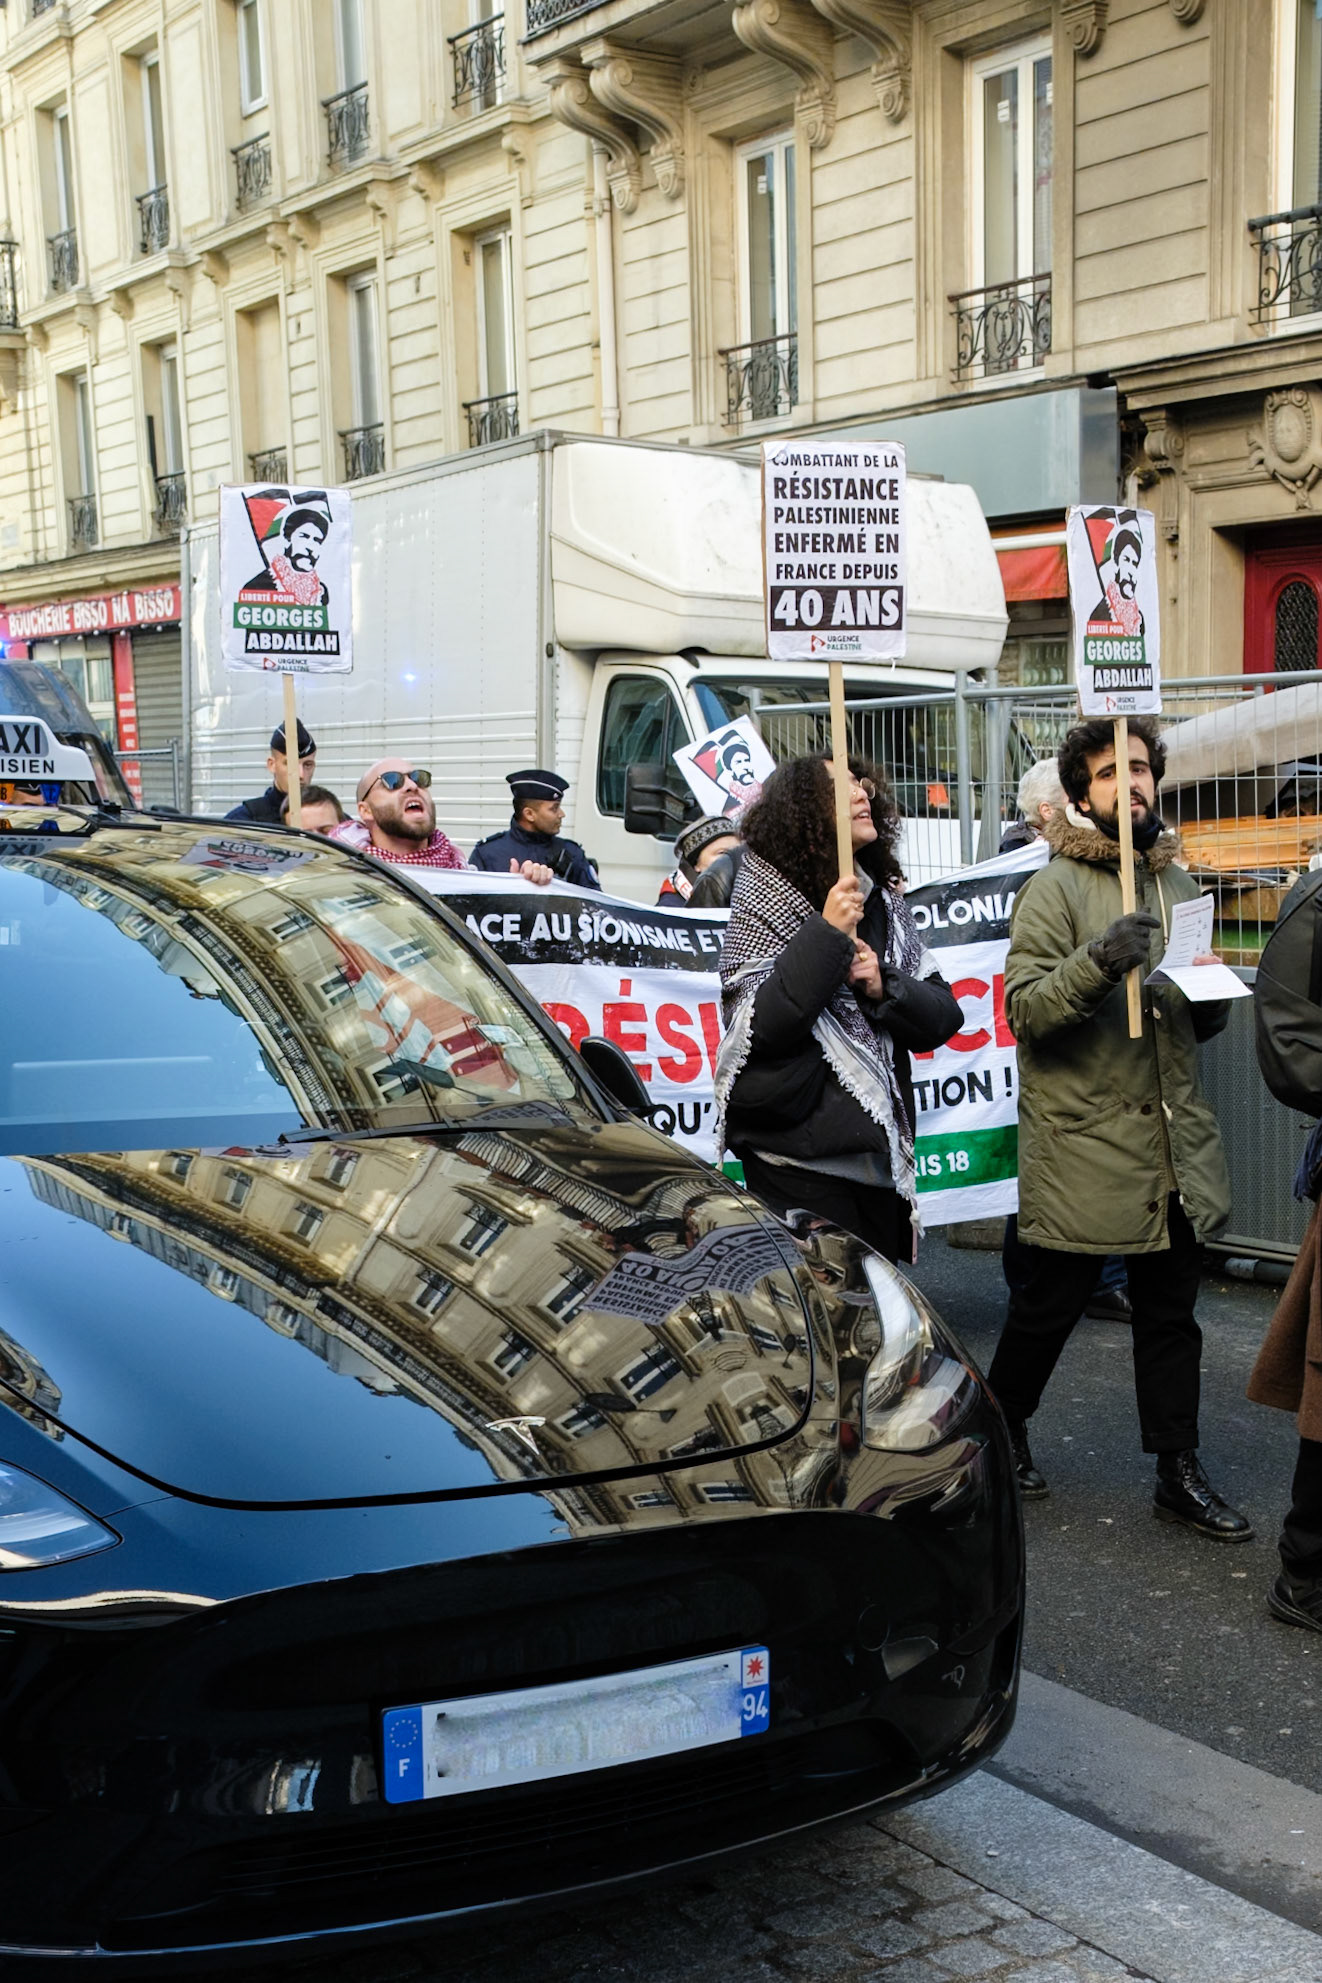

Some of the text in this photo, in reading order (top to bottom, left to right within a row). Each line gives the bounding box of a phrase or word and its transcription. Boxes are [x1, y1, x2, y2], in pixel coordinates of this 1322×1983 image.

[863, 455, 879, 467] DE
[884, 455, 899, 468] LA
[773, 471, 899, 500] RÉSISTANCE
[774, 507, 899, 524] PALESTINIENNE
[775, 528, 899, 553] ENFERMÉ EN
[776, 563, 898, 580] FRANCE DEPUIS
[272, 594, 295, 603] POUR
[774, 589, 900, 626] 40 ANS
[8, 588, 174, 637] BOUCHERIE BISSO NA BISSO
[237, 606, 324, 628] GEORGES
[246, 631, 339, 652] ABDALLAH
[827, 635, 860, 643] URGENCE
[1087, 640, 1142, 661] GEORGES
[1094, 668, 1152, 688] ABDALLAH
[530, 913, 572, 942] AU
[577, 914, 694, 953] SIONISME
[698, 929, 727, 953] ET
[912, 1070, 993, 1111] TION
[1004, 1066, 1012, 1097] !
[946, 1150, 970, 1172] 18
[743, 1690, 768, 1721] 94
[399, 1757, 410, 1778] F
